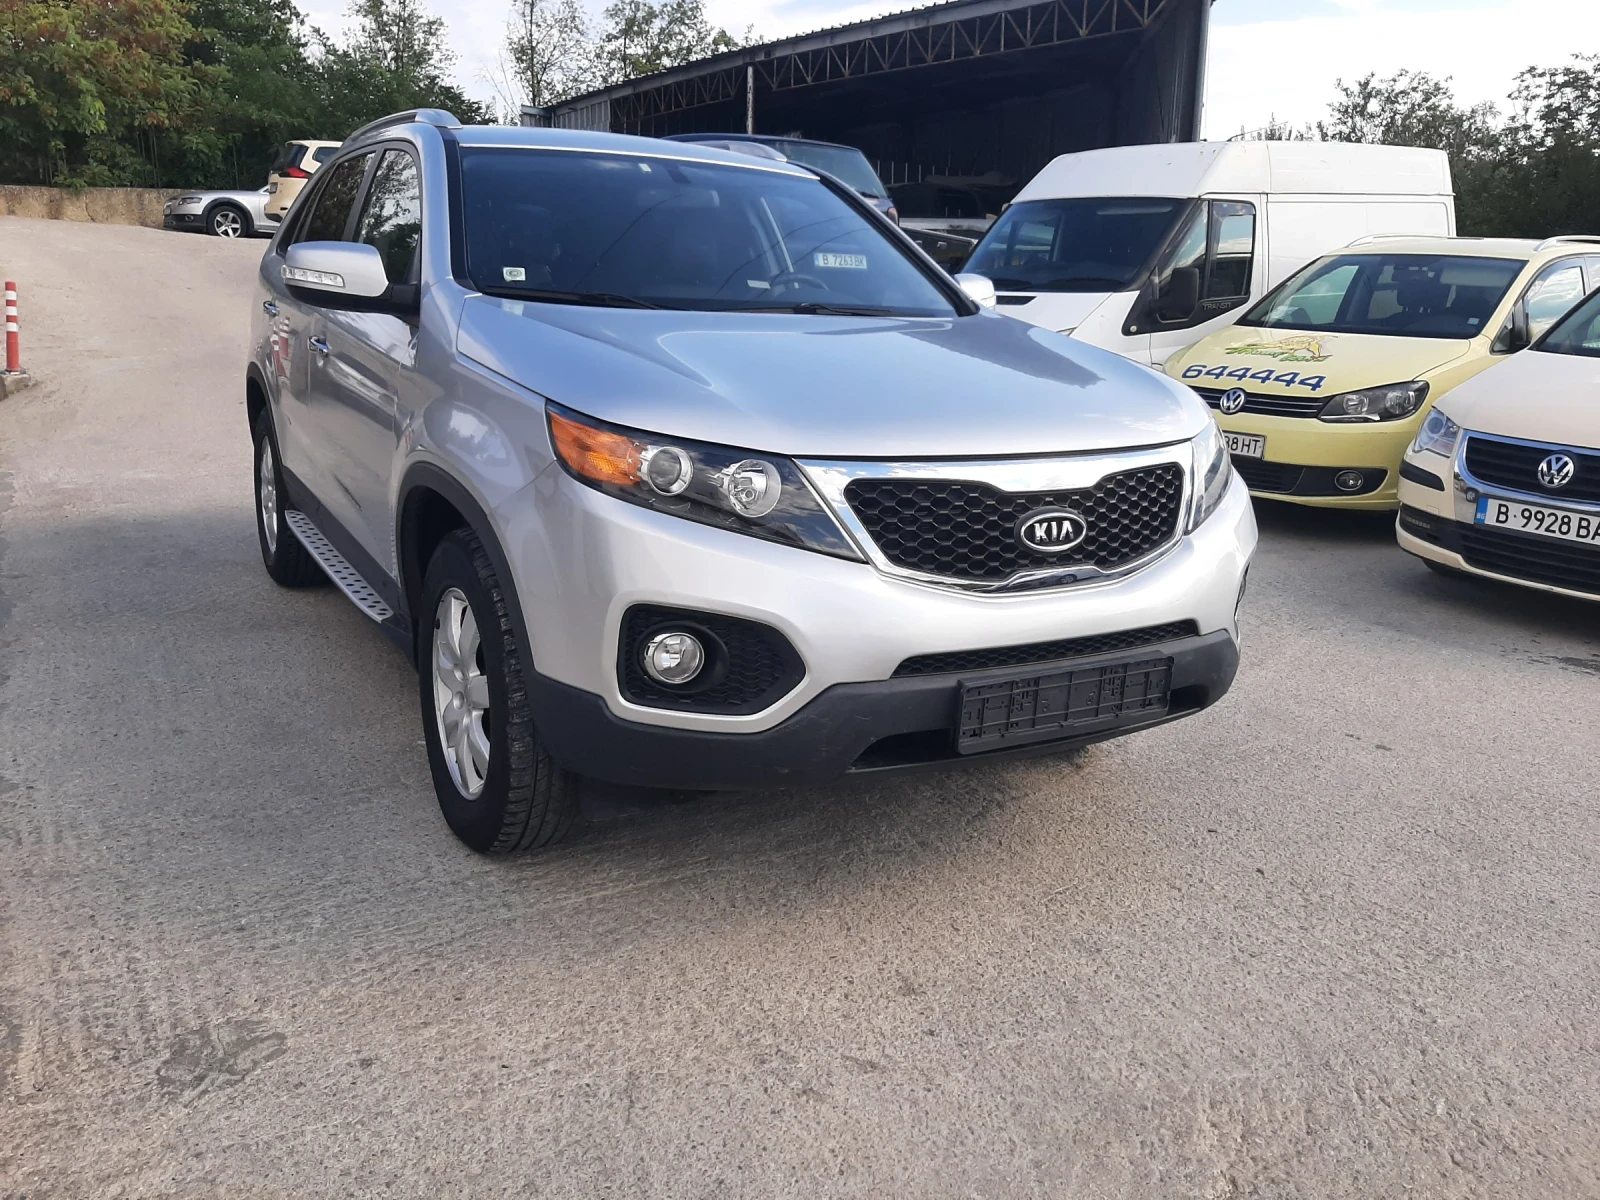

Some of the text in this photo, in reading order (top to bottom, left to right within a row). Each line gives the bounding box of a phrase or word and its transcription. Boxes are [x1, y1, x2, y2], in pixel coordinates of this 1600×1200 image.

[1202, 302, 1231, 310] TRANSIT
[1181, 364, 1326, 391] 644444
[1034, 520, 1074, 543] KIA
